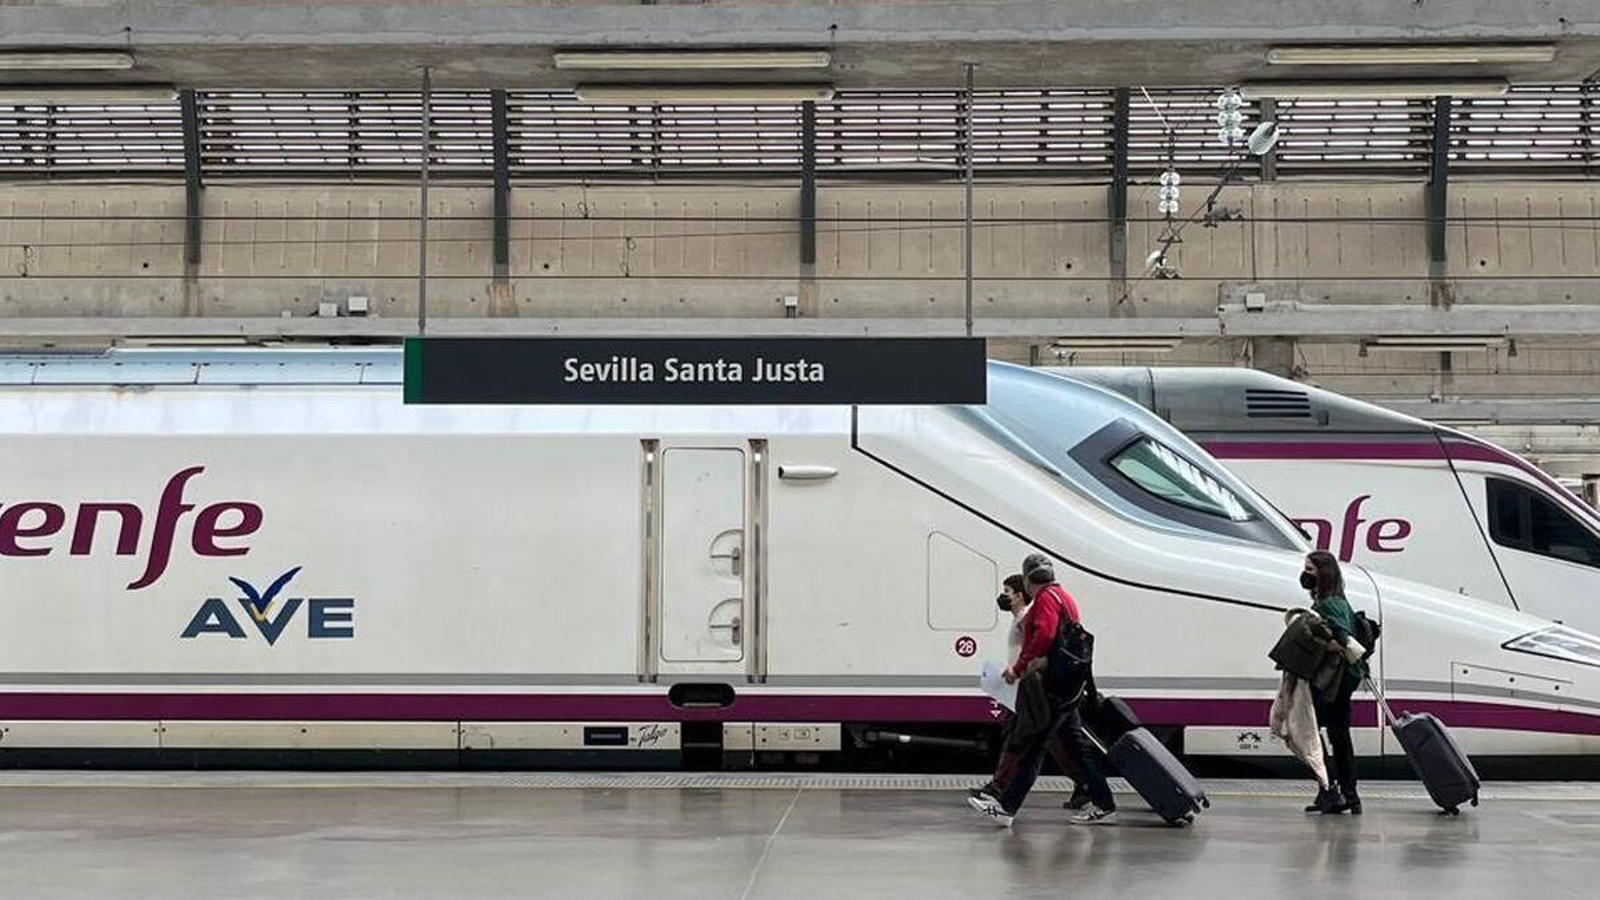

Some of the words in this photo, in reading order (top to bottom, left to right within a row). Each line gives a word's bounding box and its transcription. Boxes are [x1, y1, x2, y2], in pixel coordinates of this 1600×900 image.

[564, 356, 655, 383] Sevilla
[664, 357, 743, 382] Santa
[751, 357, 825, 382] Justa
[0, 466, 264, 590] enfe
[1291, 495, 1412, 563] nfe
[180, 597, 354, 646] AVE
